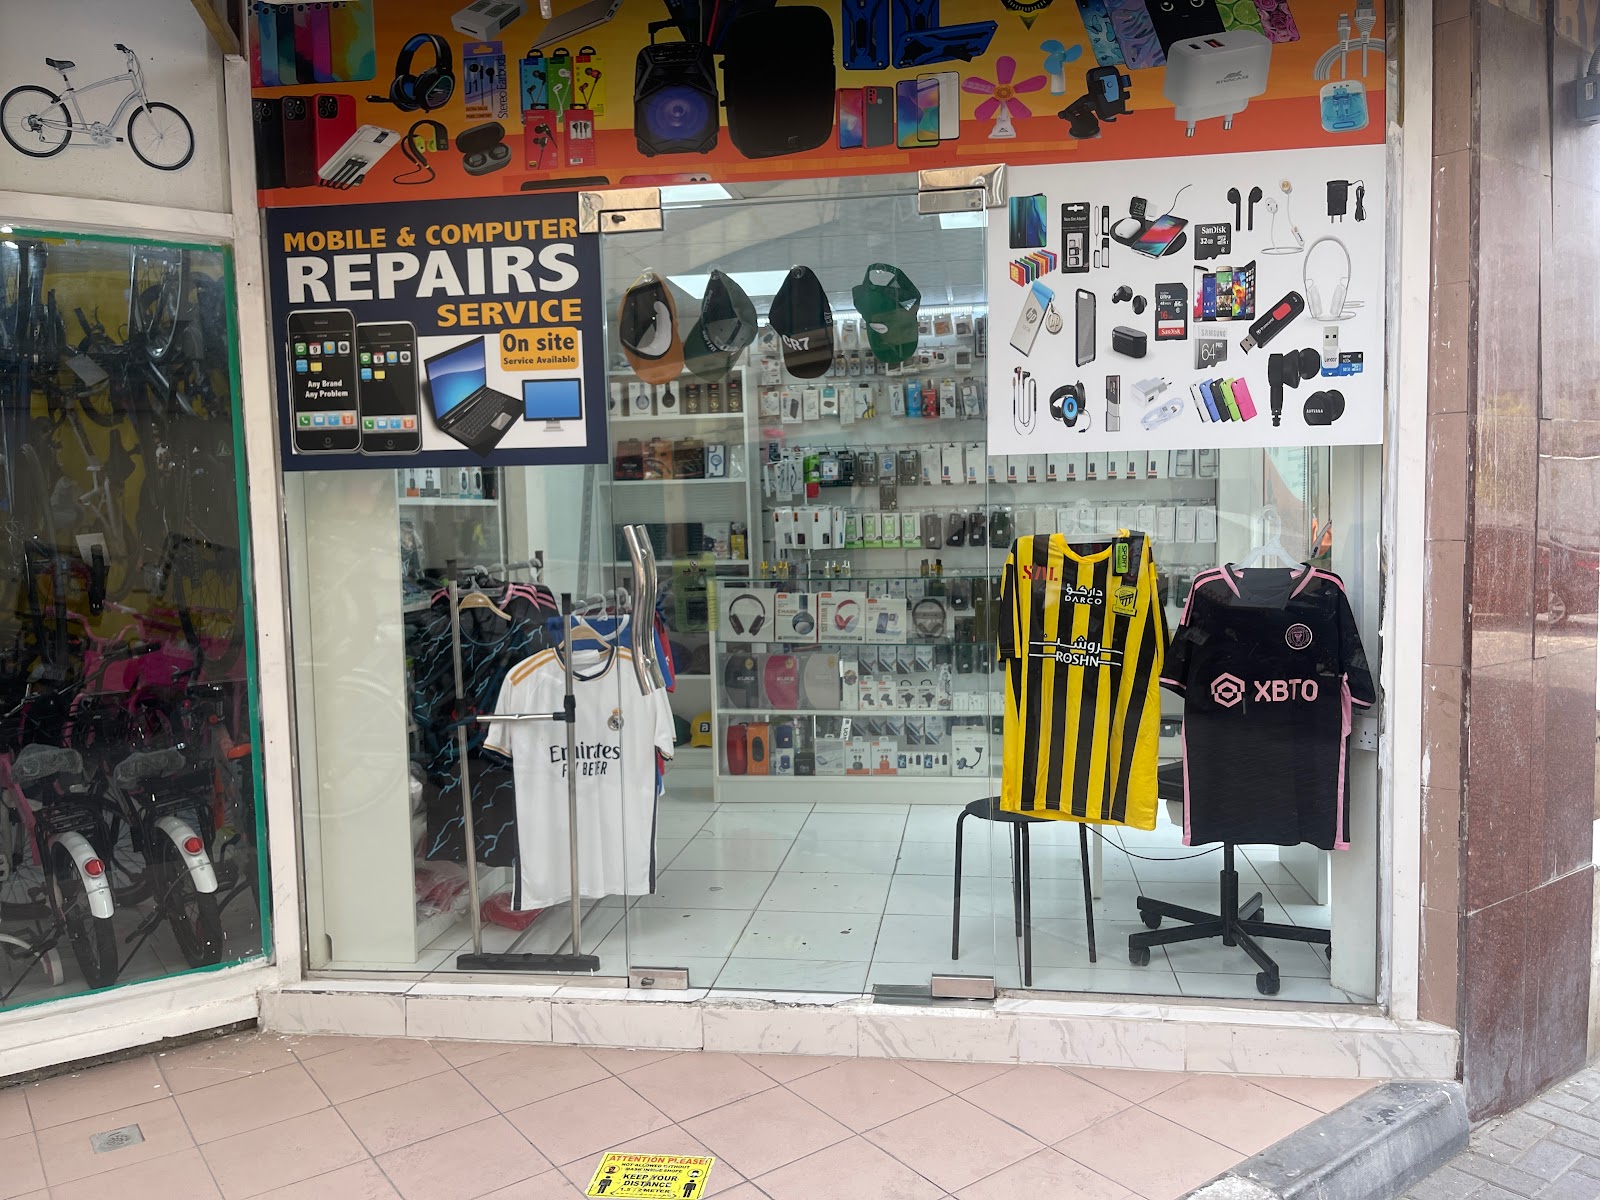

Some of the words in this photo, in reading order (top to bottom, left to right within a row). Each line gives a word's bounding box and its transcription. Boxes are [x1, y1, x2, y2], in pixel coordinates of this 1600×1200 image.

[497, 54, 509, 91] Earbuds
[466, 79, 478, 96] J1
[498, 92, 509, 119] Stereo
[284, 228, 386, 253] MOBILE
[397, 225, 416, 247] &
[425, 217, 578, 246] COMPUTER
[1201, 225, 1227, 235] SanDisk
[286, 243, 581, 304] REPAIRS
[436, 297, 583, 328] SERVICE
[1026, 308, 1038, 324] hp
[1159, 310, 1168, 320] 16
[1161, 328, 1181, 336] SanDisk
[1200, 328, 1227, 338] SAMSUNG
[503, 333, 529, 353] On
[536, 332, 575, 351] site
[701, 330, 712, 345] SOFT
[708, 343, 718, 353] FIT
[782, 334, 810, 352] CR7
[504, 356, 534, 365] Service
[536, 355, 576, 364] Available
[1201, 343, 1216, 361] 64
[307, 380, 321, 390] Any
[321, 379, 343, 388] Brand
[305, 390, 319, 400] Any
[319, 389, 349, 398] Problem
[1064, 594, 1103, 606] DARCO
[1056, 651, 1100, 668] ROSHN
[1253, 678, 1320, 703] XBTO
[609, 1155, 666, 1164] ATTENTION
[667, 1157, 709, 1167] PLEASE!
[623, 1180, 672, 1188] DISTANCE
